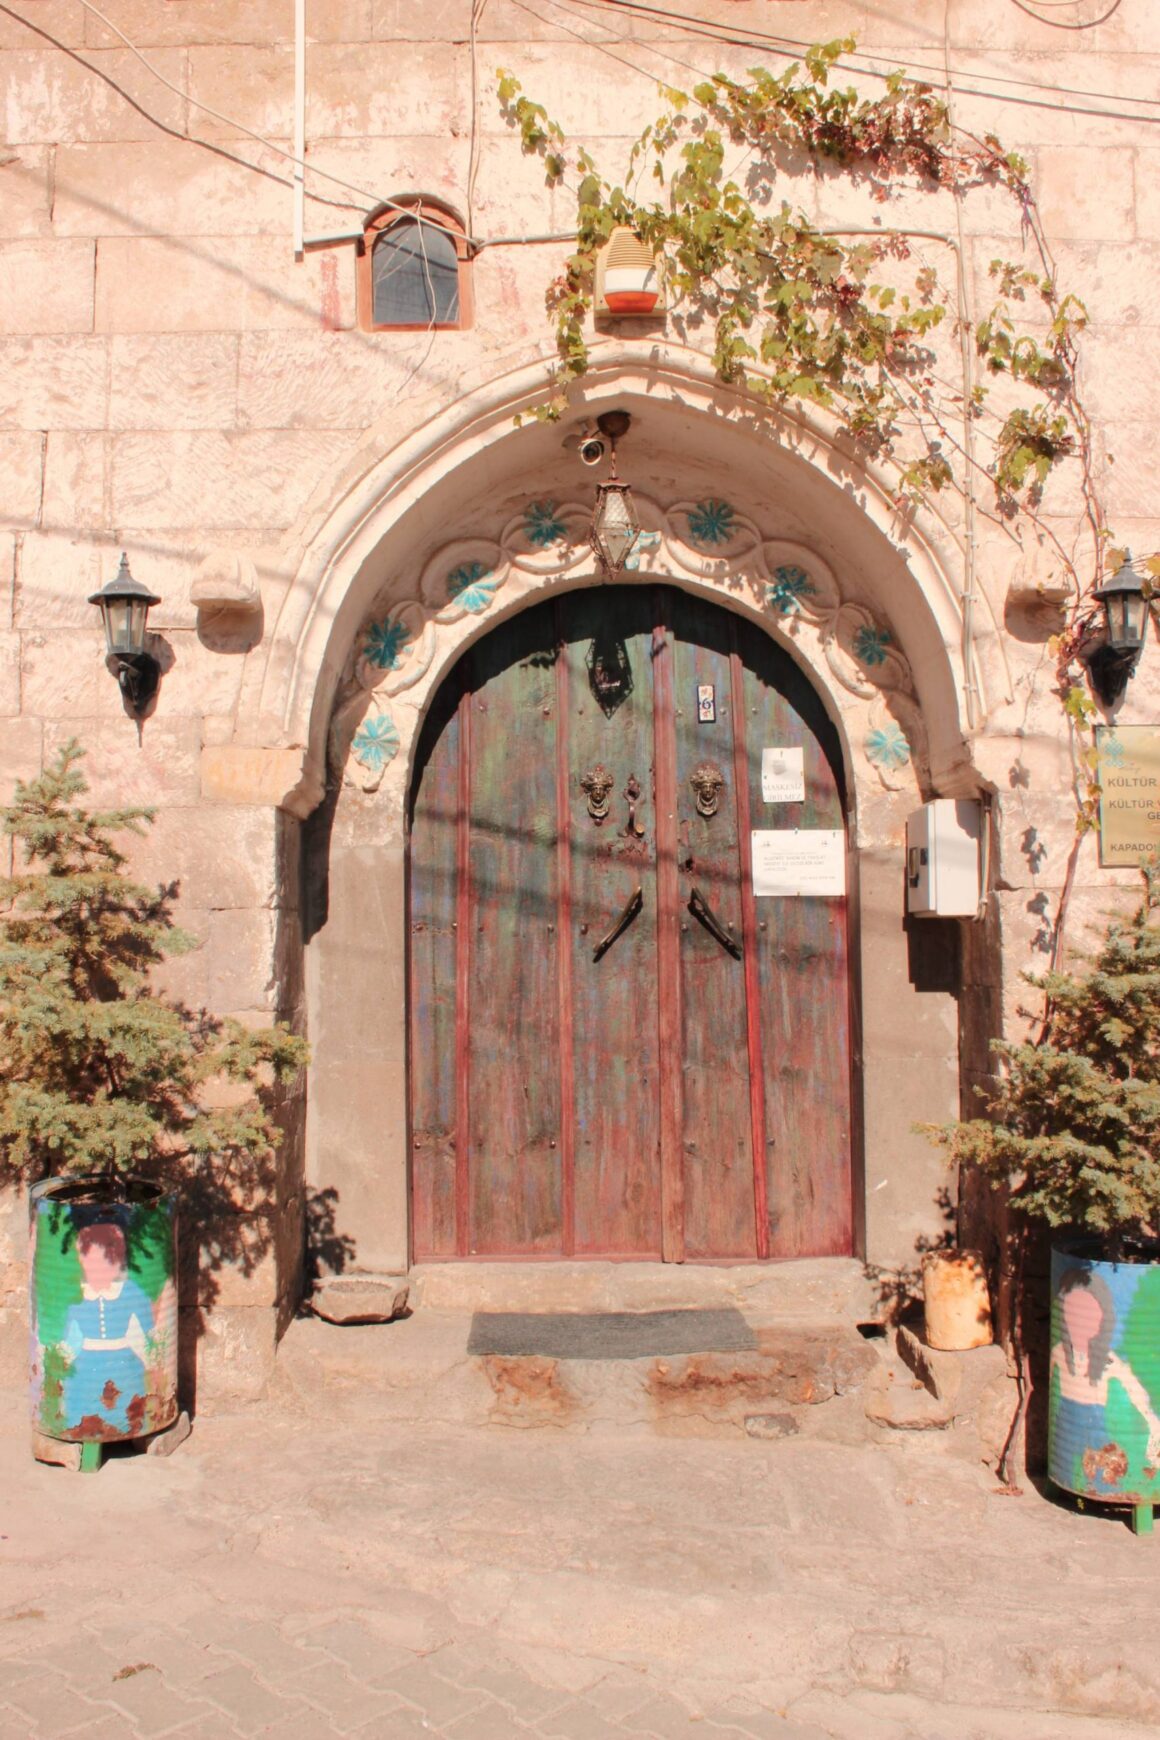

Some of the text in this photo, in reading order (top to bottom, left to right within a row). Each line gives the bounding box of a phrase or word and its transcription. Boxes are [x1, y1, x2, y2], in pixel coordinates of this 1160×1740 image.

[702, 698, 711, 710] 6
[1107, 777, 1157, 787] KÜLTÜR
[1109, 799, 1154, 809] KÜLTÜR
